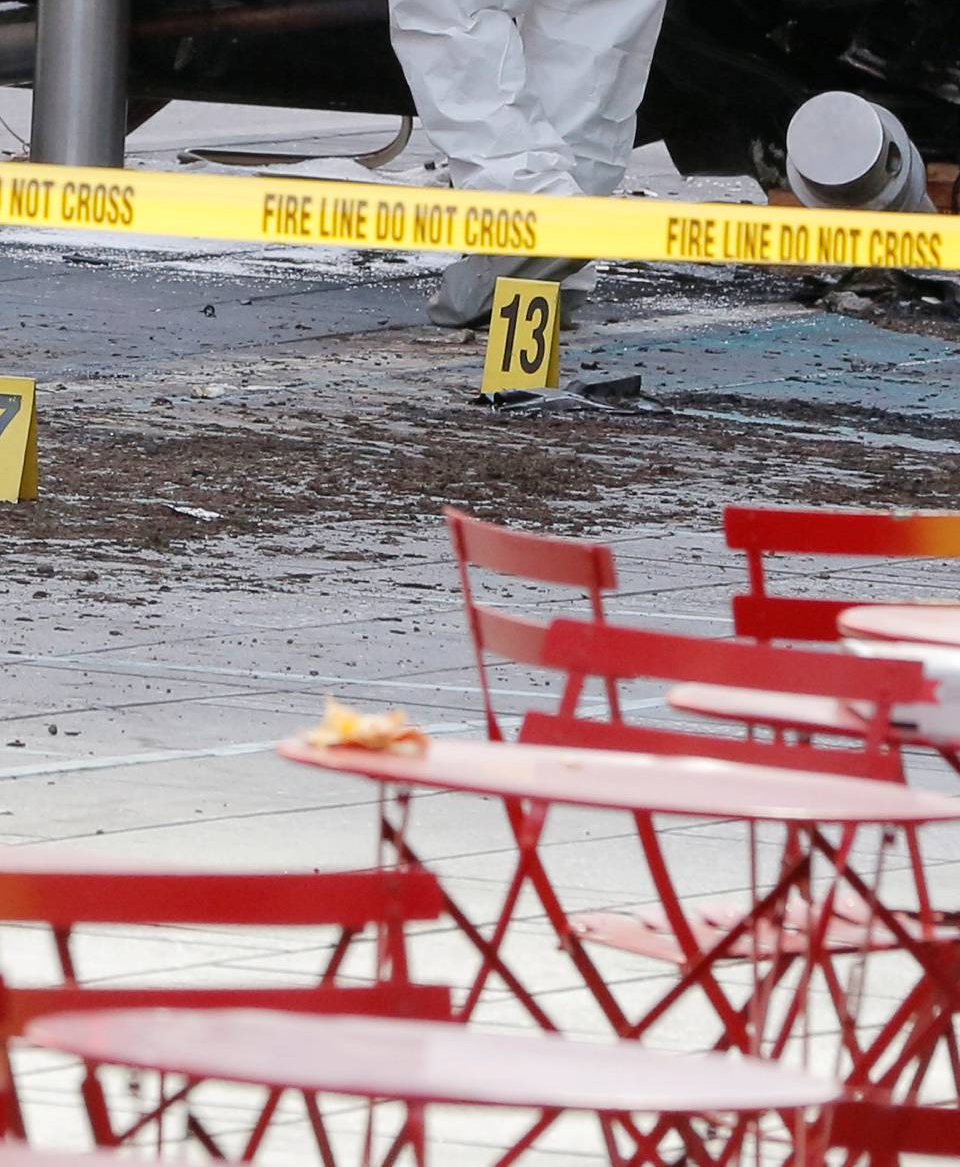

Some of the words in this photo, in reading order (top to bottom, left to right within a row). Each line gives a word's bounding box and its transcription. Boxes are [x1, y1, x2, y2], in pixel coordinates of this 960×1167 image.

[10, 178, 54, 218] NOT
[62, 181, 135, 226] CROSS
[262, 193, 313, 235] FIRE
[320, 197, 368, 239] LINE
[376, 200, 405, 241] DO
[413, 203, 457, 245] NOT
[464, 206, 538, 250] CROSS
[666, 218, 715, 257] FIRE
[723, 220, 772, 260] LINE
[780, 224, 809, 262] DO
[817, 226, 862, 265] NOT
[869, 229, 944, 268] CROSS
[500, 294, 549, 374] 13
